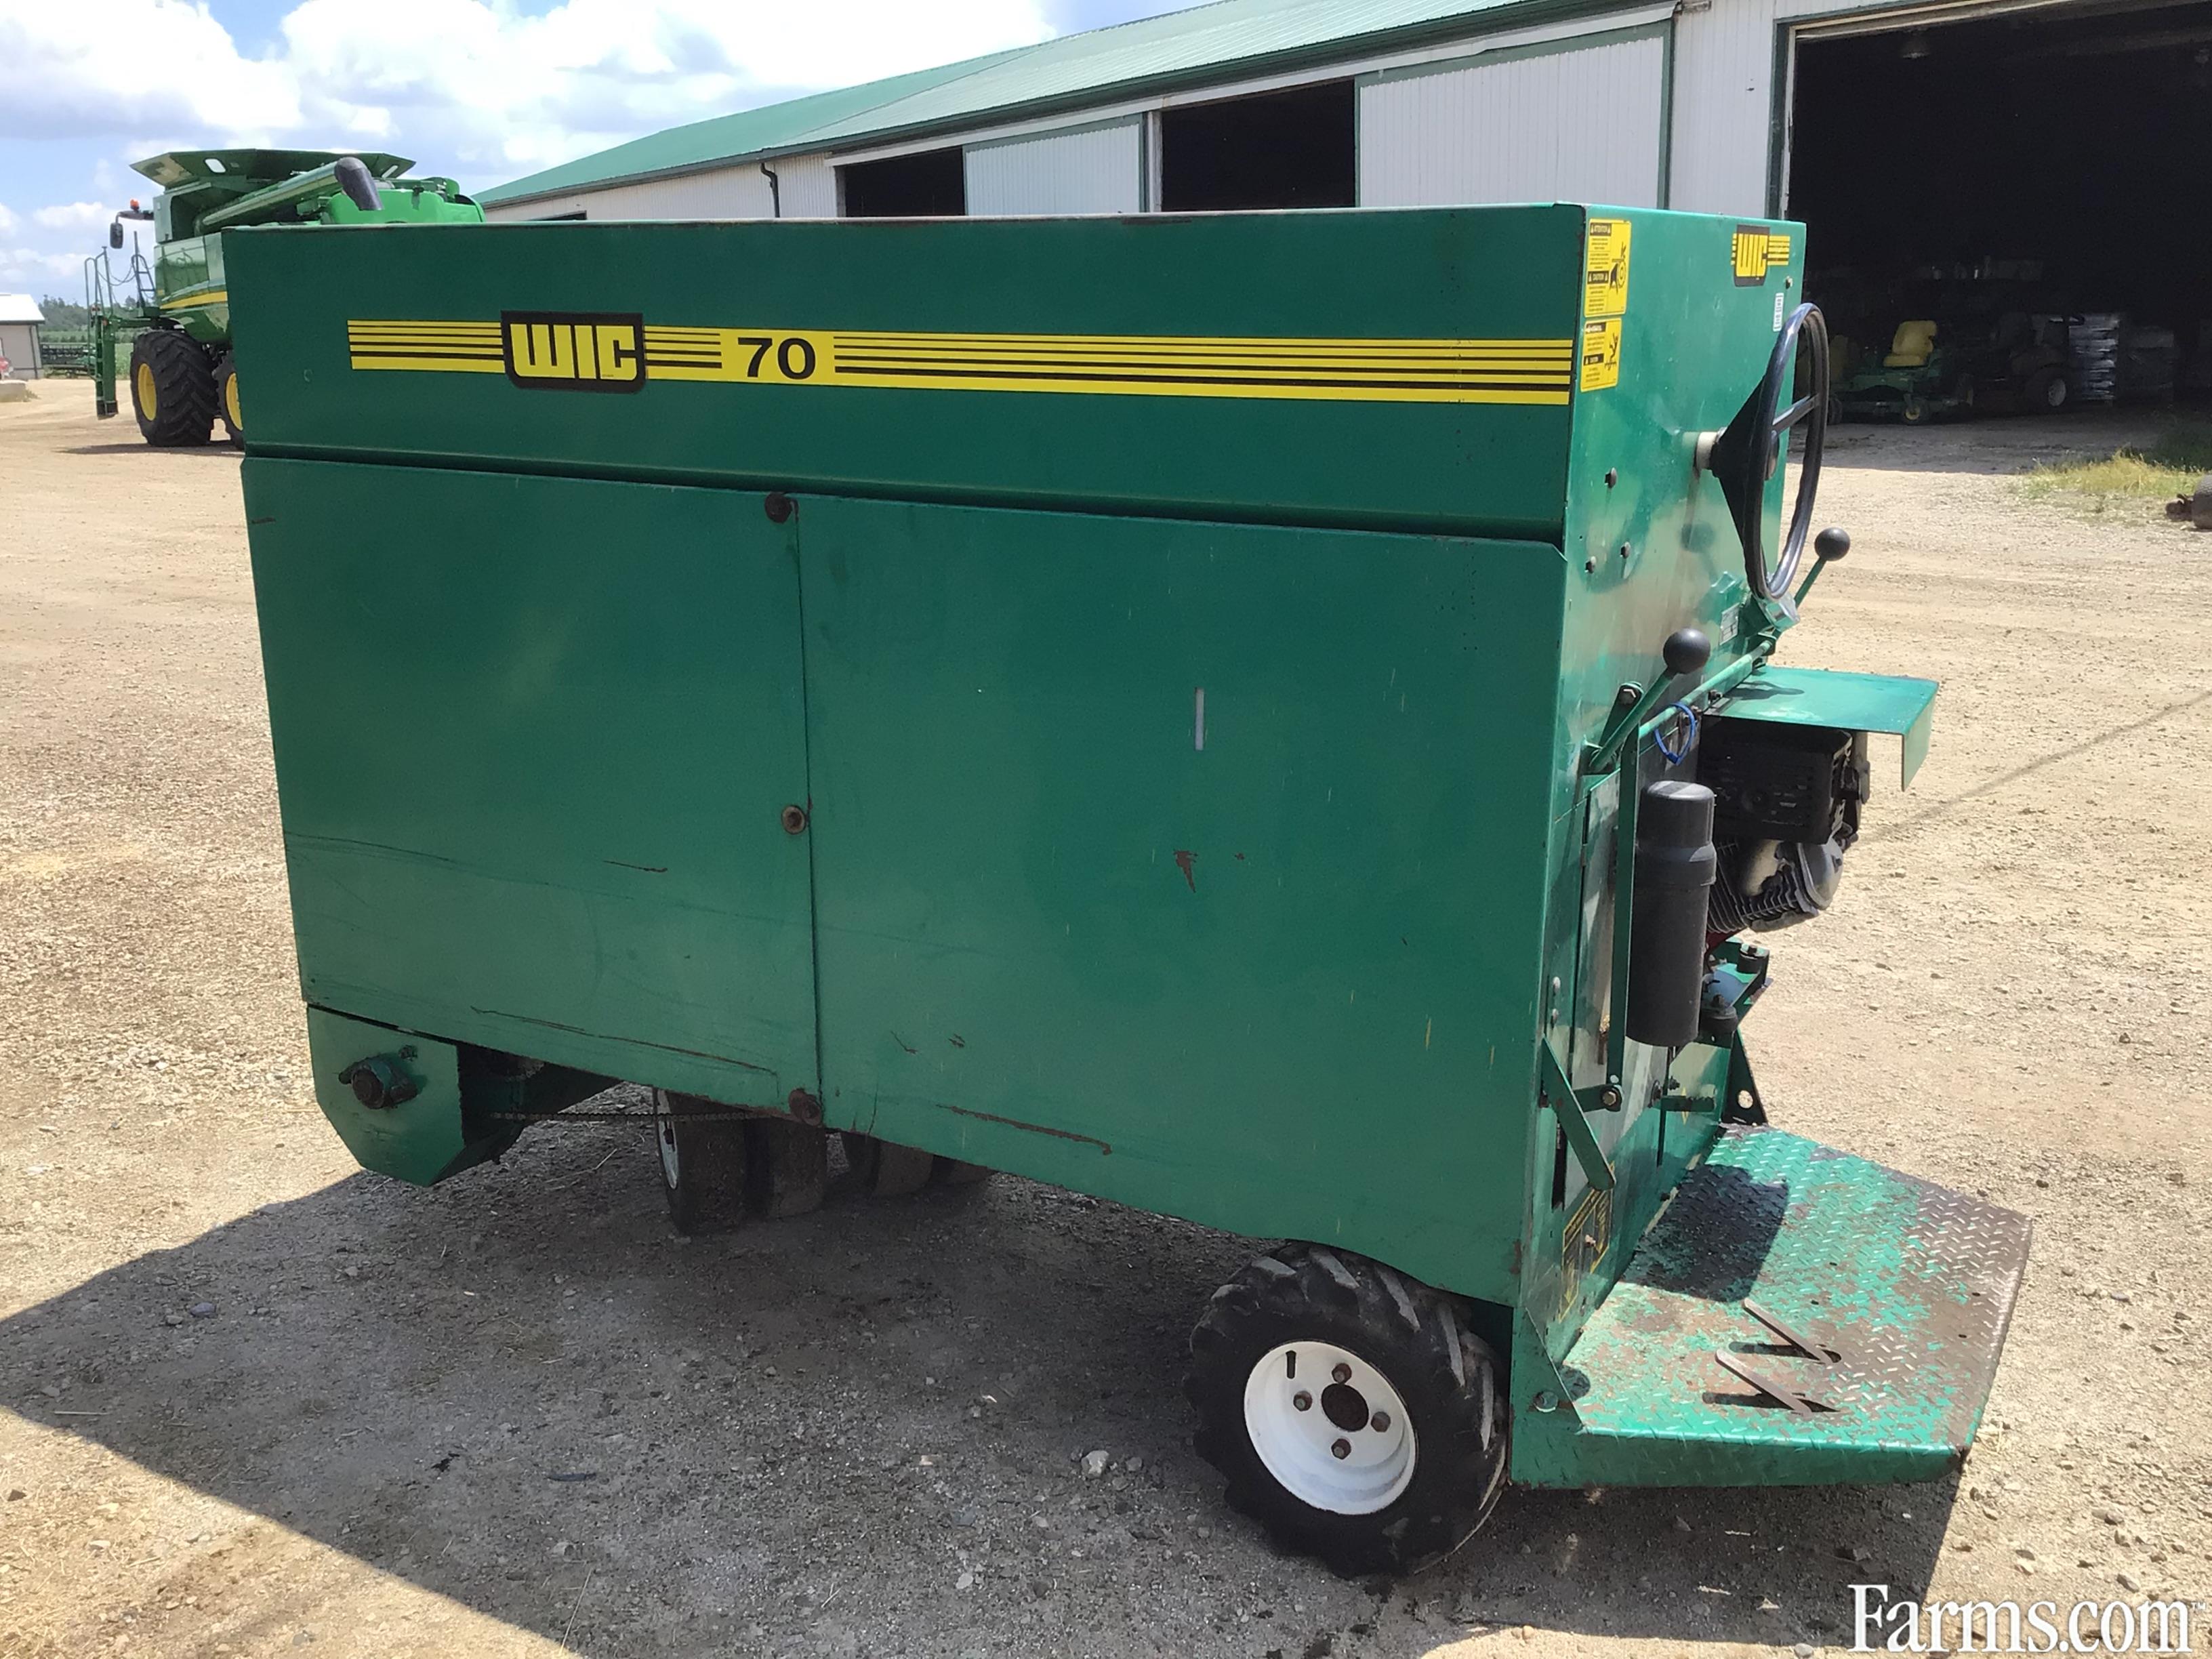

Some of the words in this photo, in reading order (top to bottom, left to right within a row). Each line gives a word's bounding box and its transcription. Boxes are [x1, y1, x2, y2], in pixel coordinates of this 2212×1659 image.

[1736, 232, 1768, 276] WIC
[510, 324, 637, 380] WIC
[737, 337, 816, 379] 70
